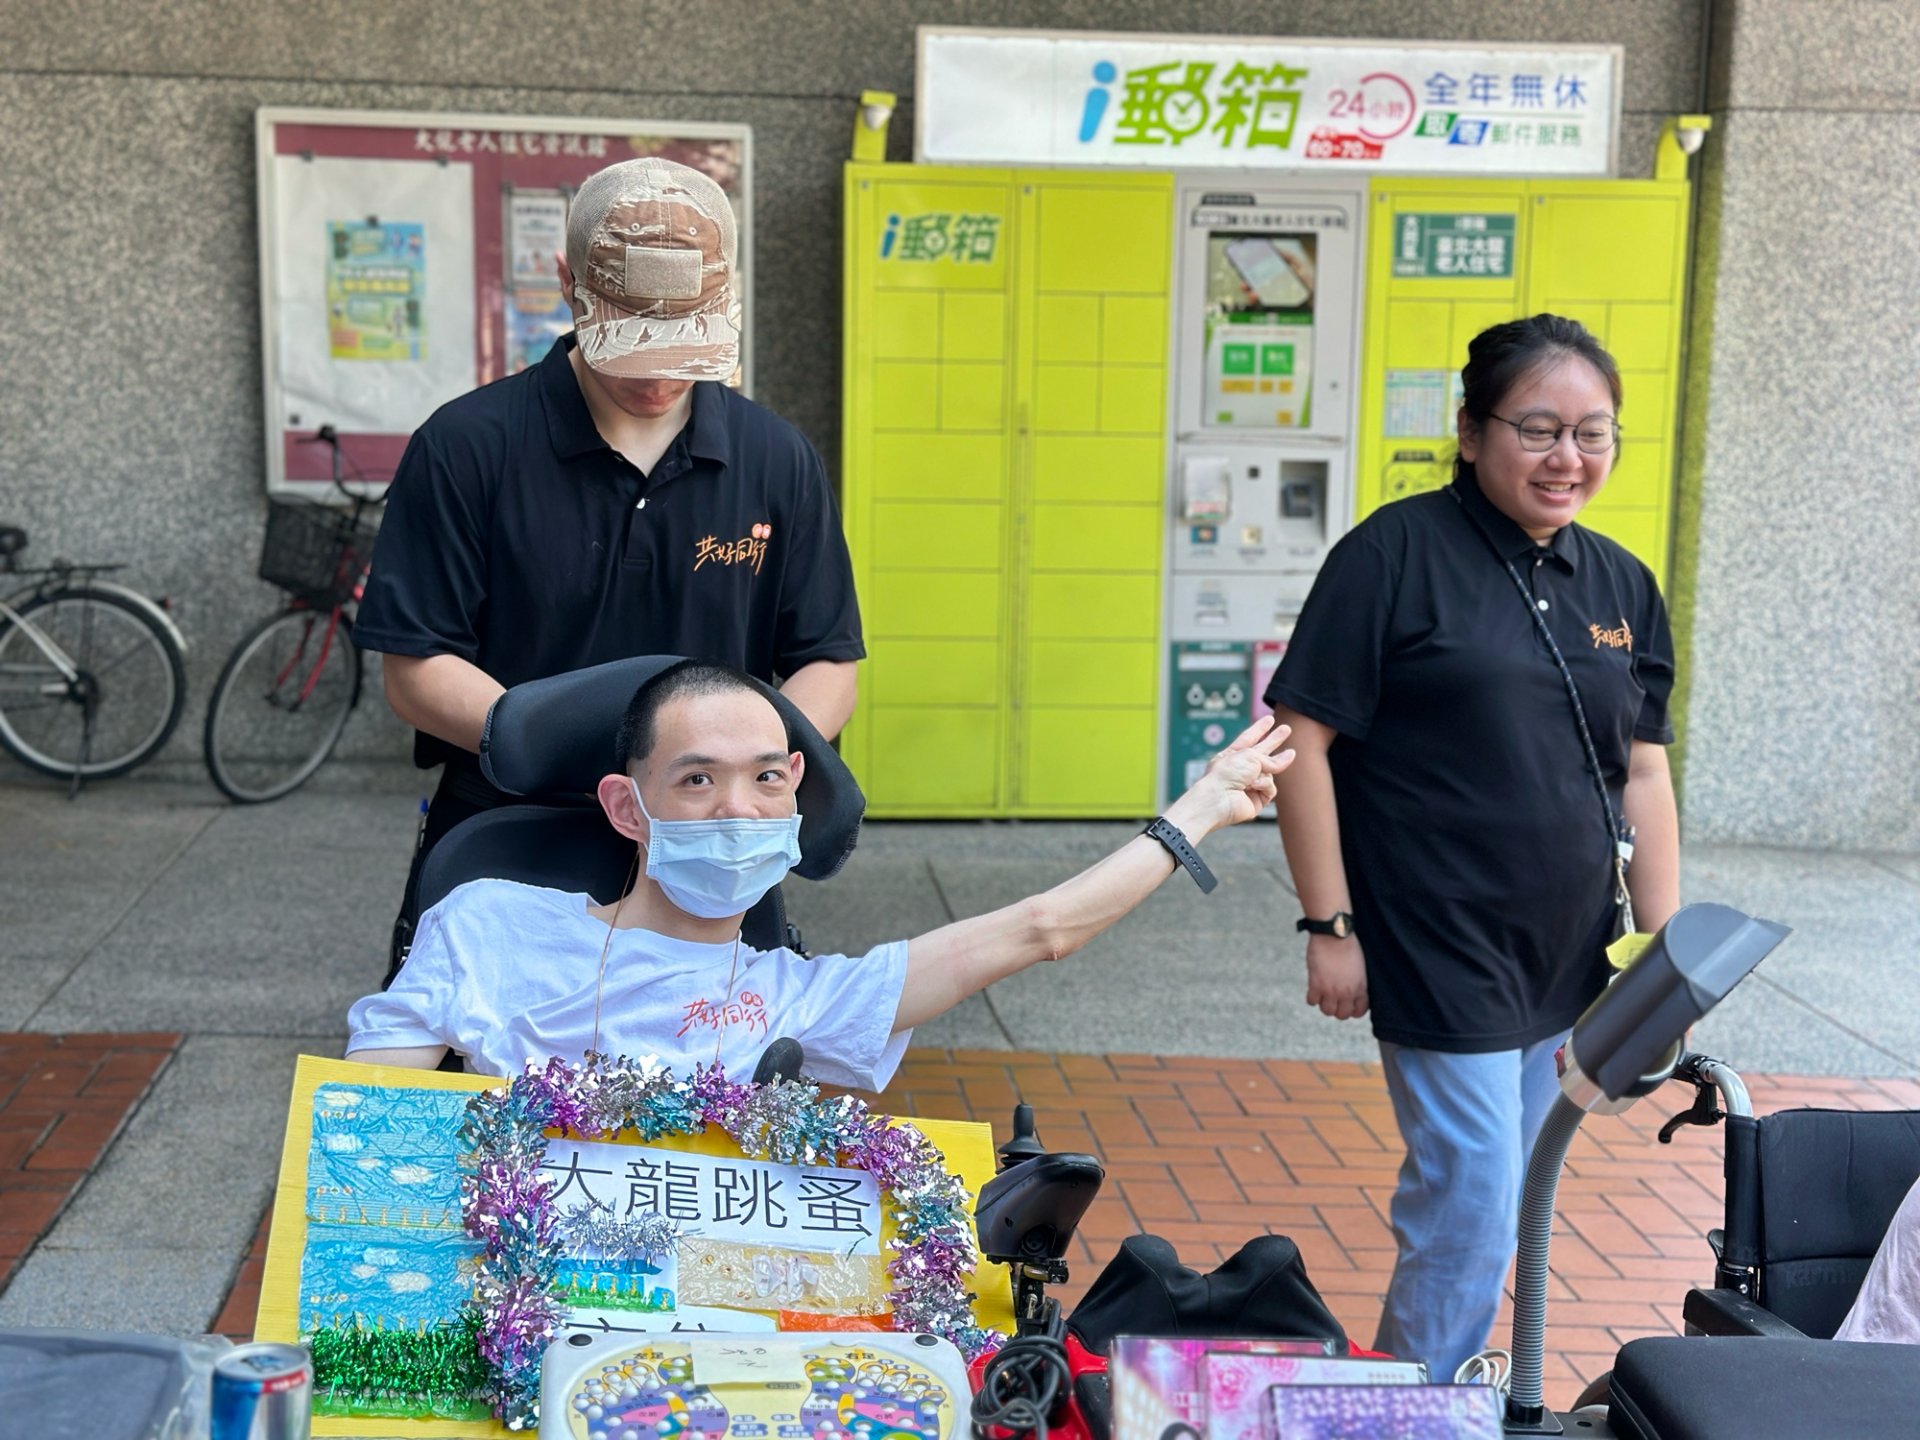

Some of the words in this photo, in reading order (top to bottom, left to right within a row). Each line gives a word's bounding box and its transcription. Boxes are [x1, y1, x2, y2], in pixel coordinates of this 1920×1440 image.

[1425, 71, 1588, 108] 全年無休
[540, 1151, 873, 1238] 大龍跳蚤
